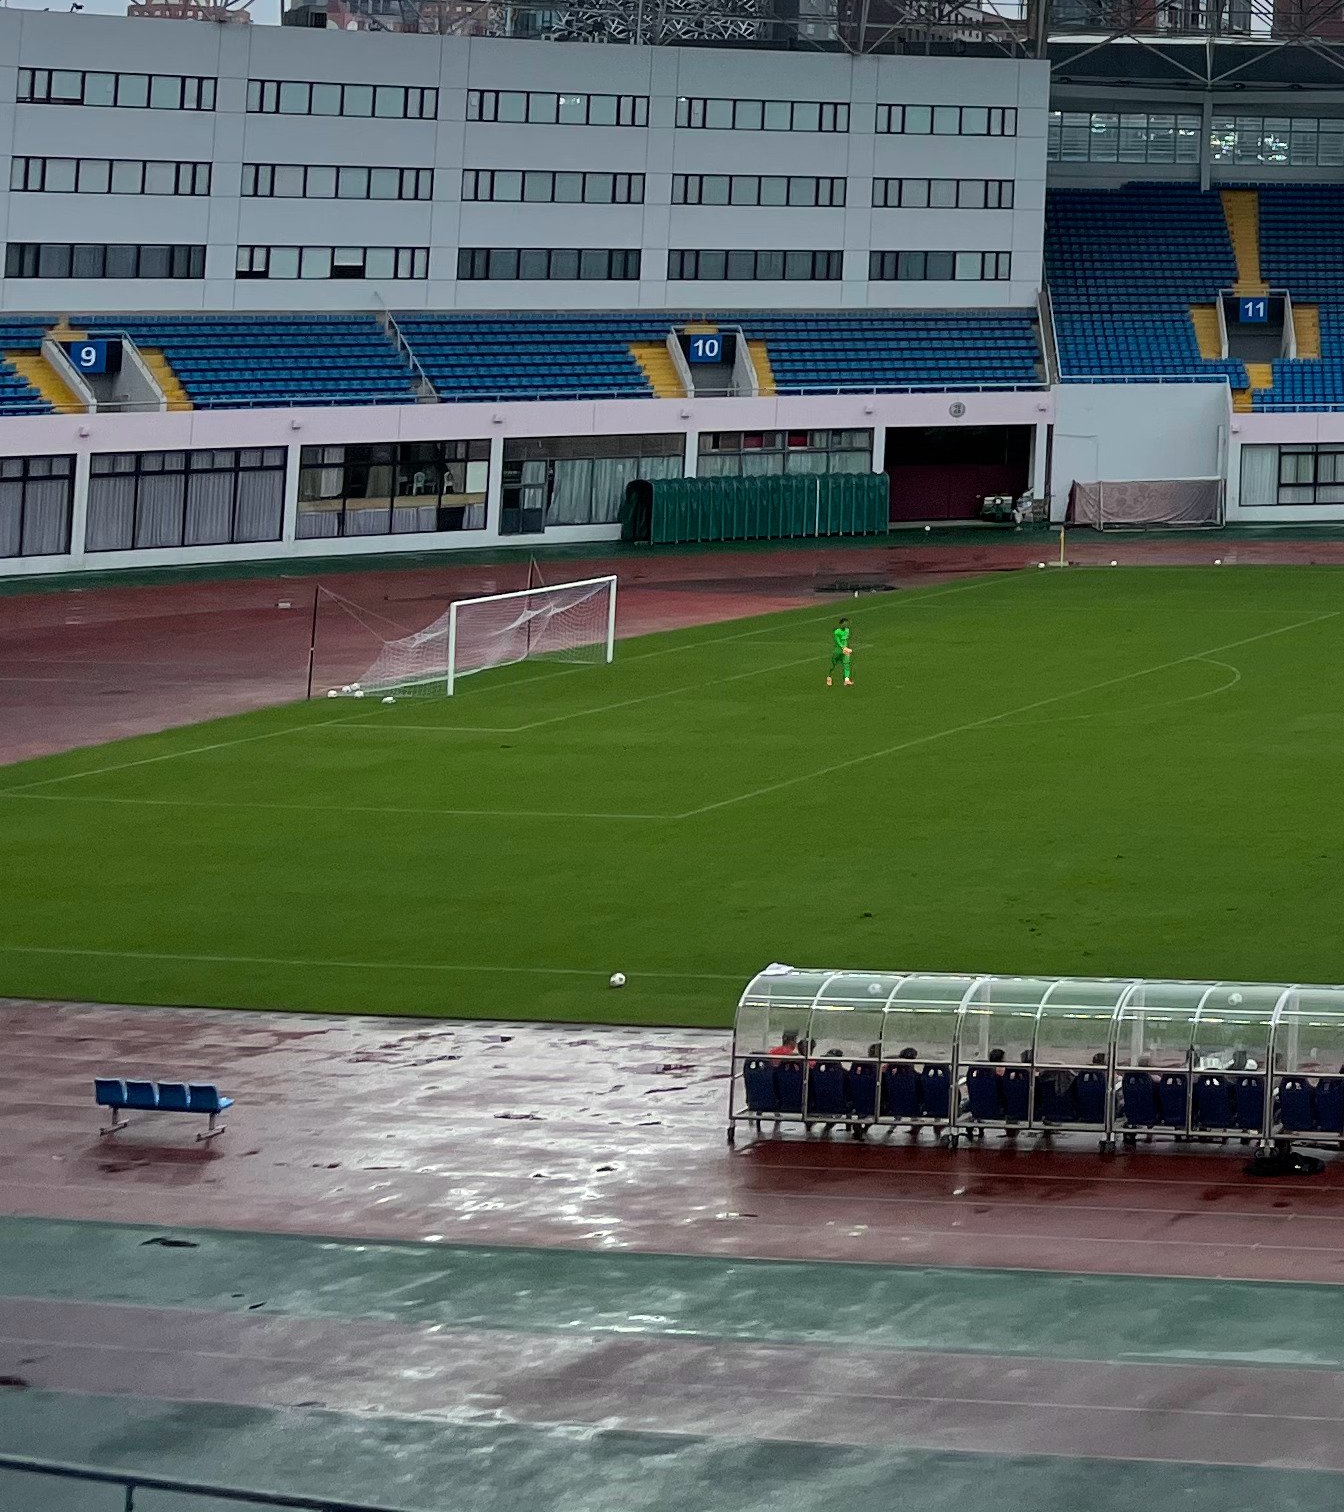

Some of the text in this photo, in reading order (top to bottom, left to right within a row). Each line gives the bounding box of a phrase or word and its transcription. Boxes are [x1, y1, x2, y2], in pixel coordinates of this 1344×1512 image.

[1244, 301, 1264, 317] 11
[80, 346, 96, 367] 9
[693, 339, 719, 357] 10
